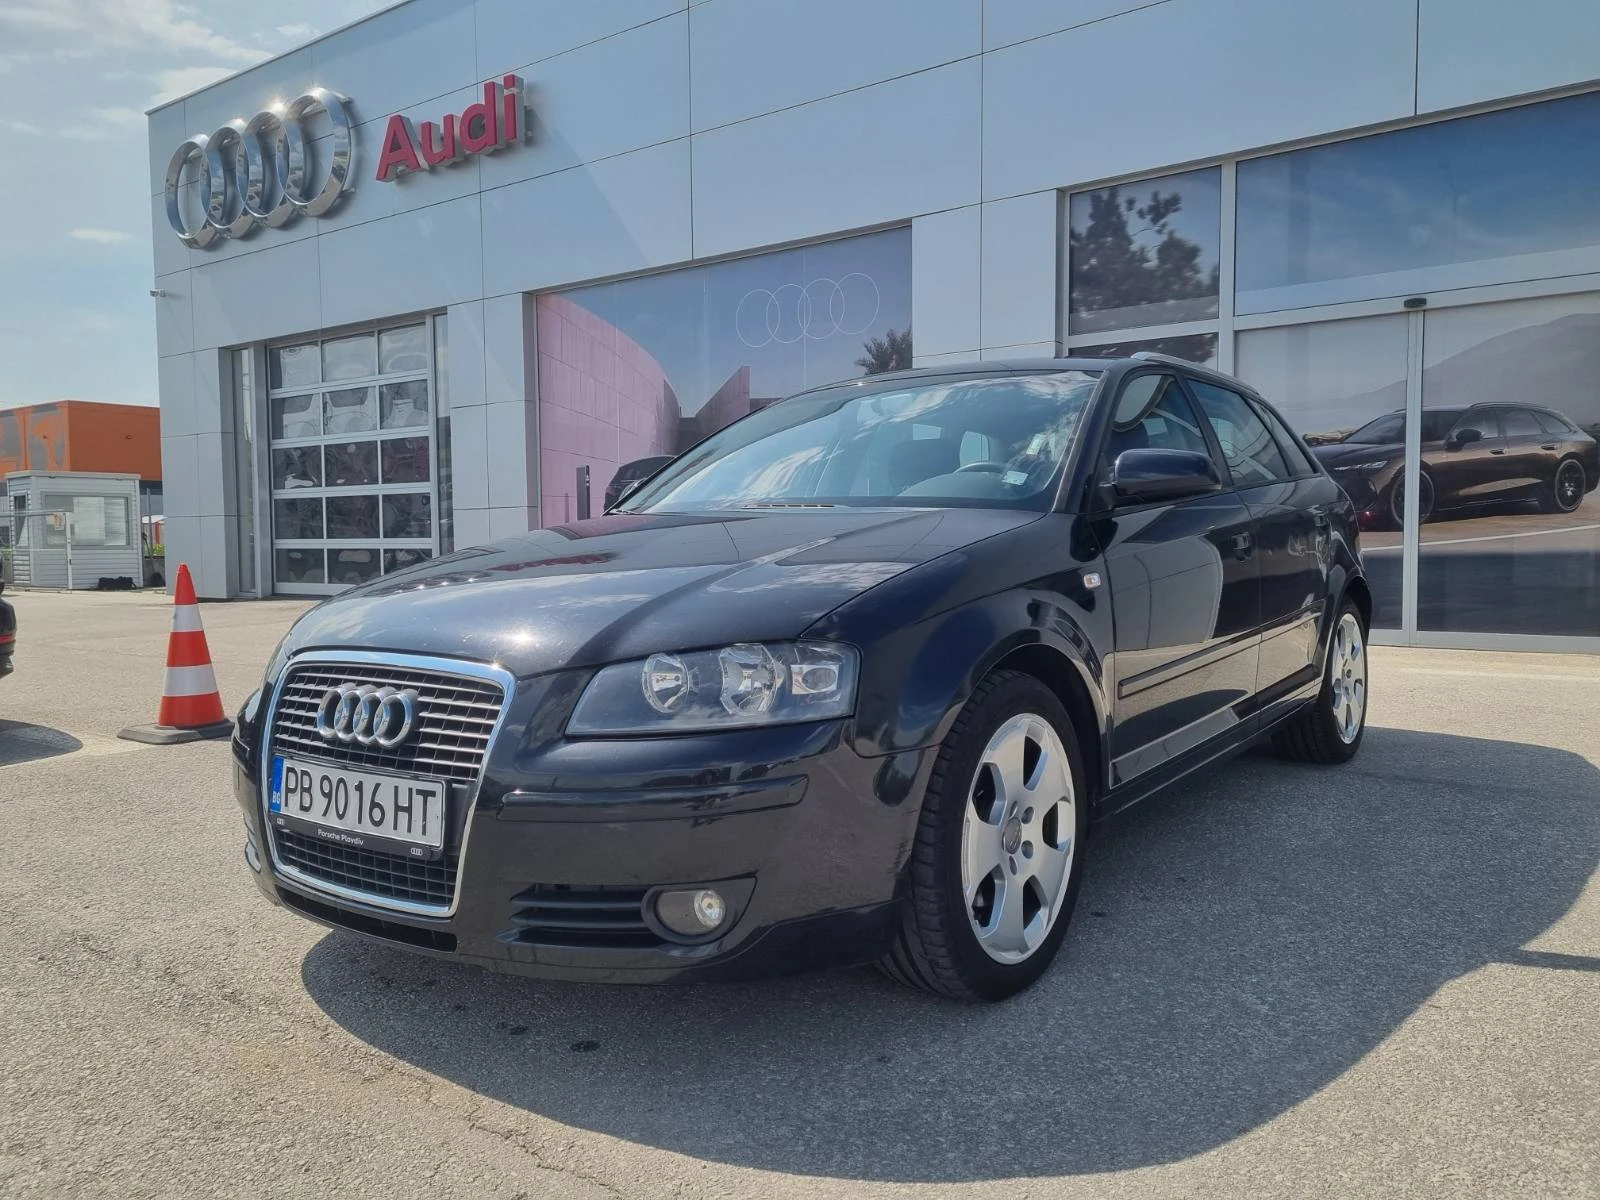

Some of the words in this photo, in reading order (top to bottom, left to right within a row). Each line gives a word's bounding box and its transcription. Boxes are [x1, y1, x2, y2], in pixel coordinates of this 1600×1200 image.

[376, 74, 521, 182] Audi
[272, 790, 281, 804] BG
[284, 765, 313, 812] PB
[319, 774, 386, 828] 9016
[392, 785, 437, 836] HT
[317, 828, 341, 841] Porsche
